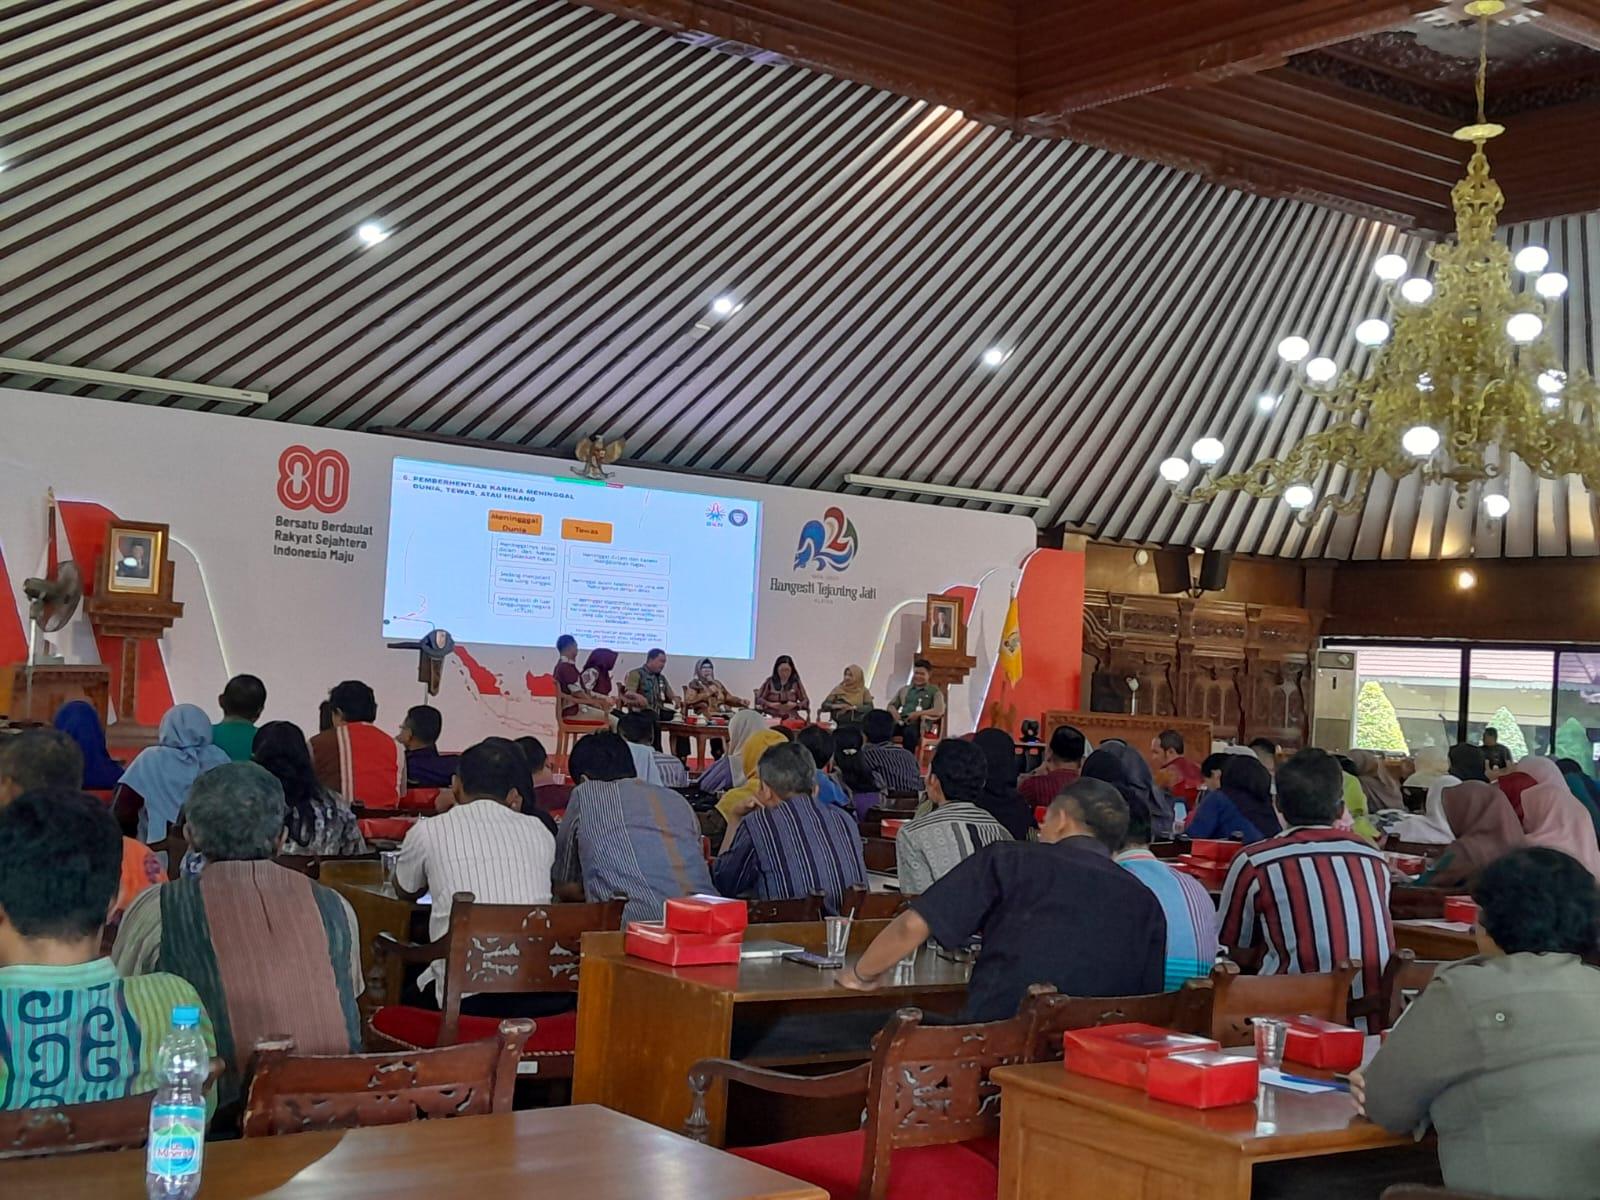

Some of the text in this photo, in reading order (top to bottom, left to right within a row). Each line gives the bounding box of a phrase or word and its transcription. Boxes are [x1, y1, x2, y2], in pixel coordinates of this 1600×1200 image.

[276, 444, 351, 514] 80
[275, 515, 373, 535] Bersatu Berdaulat
[274, 530, 367, 549] Rakyat Sejahtera
[273, 545, 354, 563] Indonesia Maju
[816, 582, 858, 601] Tejaning
[860, 586, 877, 600] Jati
